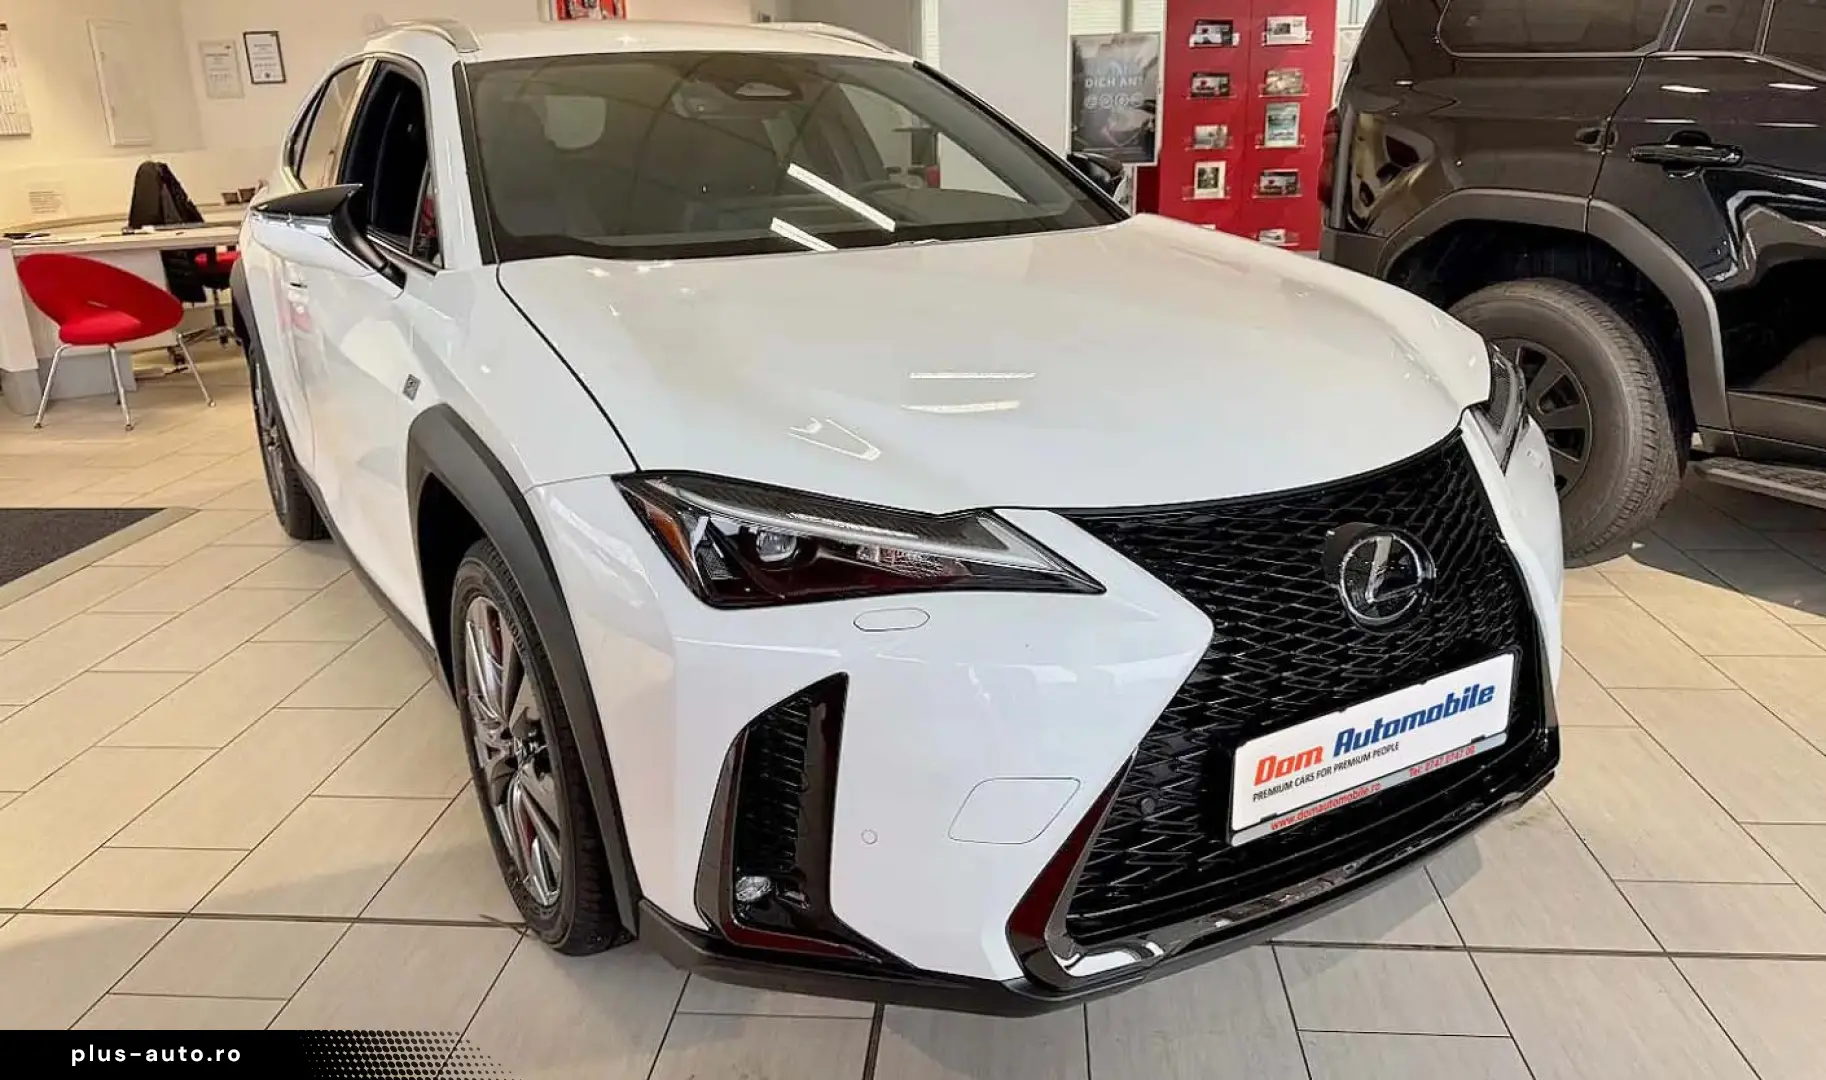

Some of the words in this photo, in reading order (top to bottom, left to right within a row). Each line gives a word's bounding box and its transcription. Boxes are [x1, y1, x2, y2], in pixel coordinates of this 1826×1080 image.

[1084, 75, 1116, 88] DICH
[1253, 745, 1325, 787] Dom
[1332, 683, 1496, 758] Automobile
[1252, 780, 1294, 803] PREMIUM
[1294, 771, 1315, 788] CARS
[1316, 766, 1332, 781] FOR
[1333, 752, 1371, 774] PREMIUM
[1372, 741, 1400, 760] PEOPLE
[1269, 782, 1384, 831] www.domautomobile.ro
